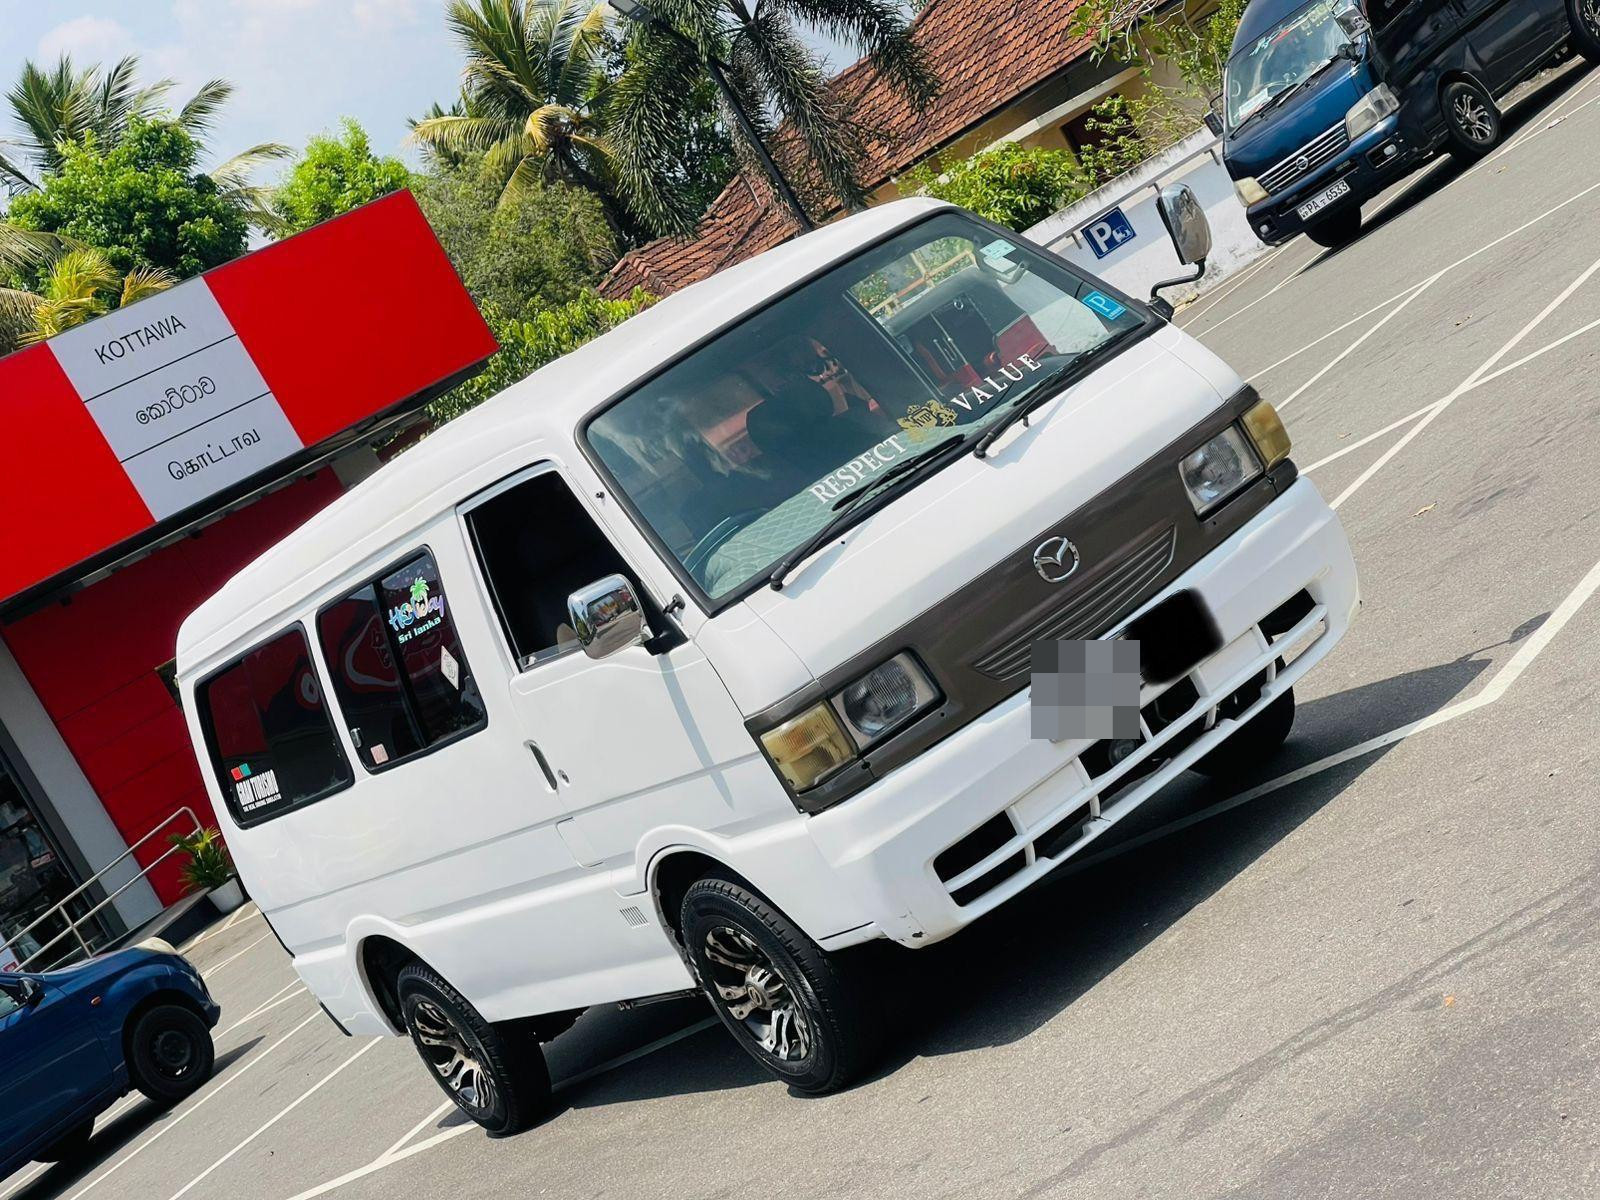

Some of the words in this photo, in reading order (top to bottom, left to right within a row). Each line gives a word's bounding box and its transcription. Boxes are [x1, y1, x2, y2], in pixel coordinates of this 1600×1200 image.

[1089, 221, 1112, 253] P
[94, 315, 186, 365] KOTTAWA
[135, 376, 216, 425] කොට්ටාව
[809, 435, 906, 504] RESPECT
[950, 354, 1042, 411] VALUE
[167, 428, 261, 481] கொட்டாவ
[398, 631, 412, 643] Sri
